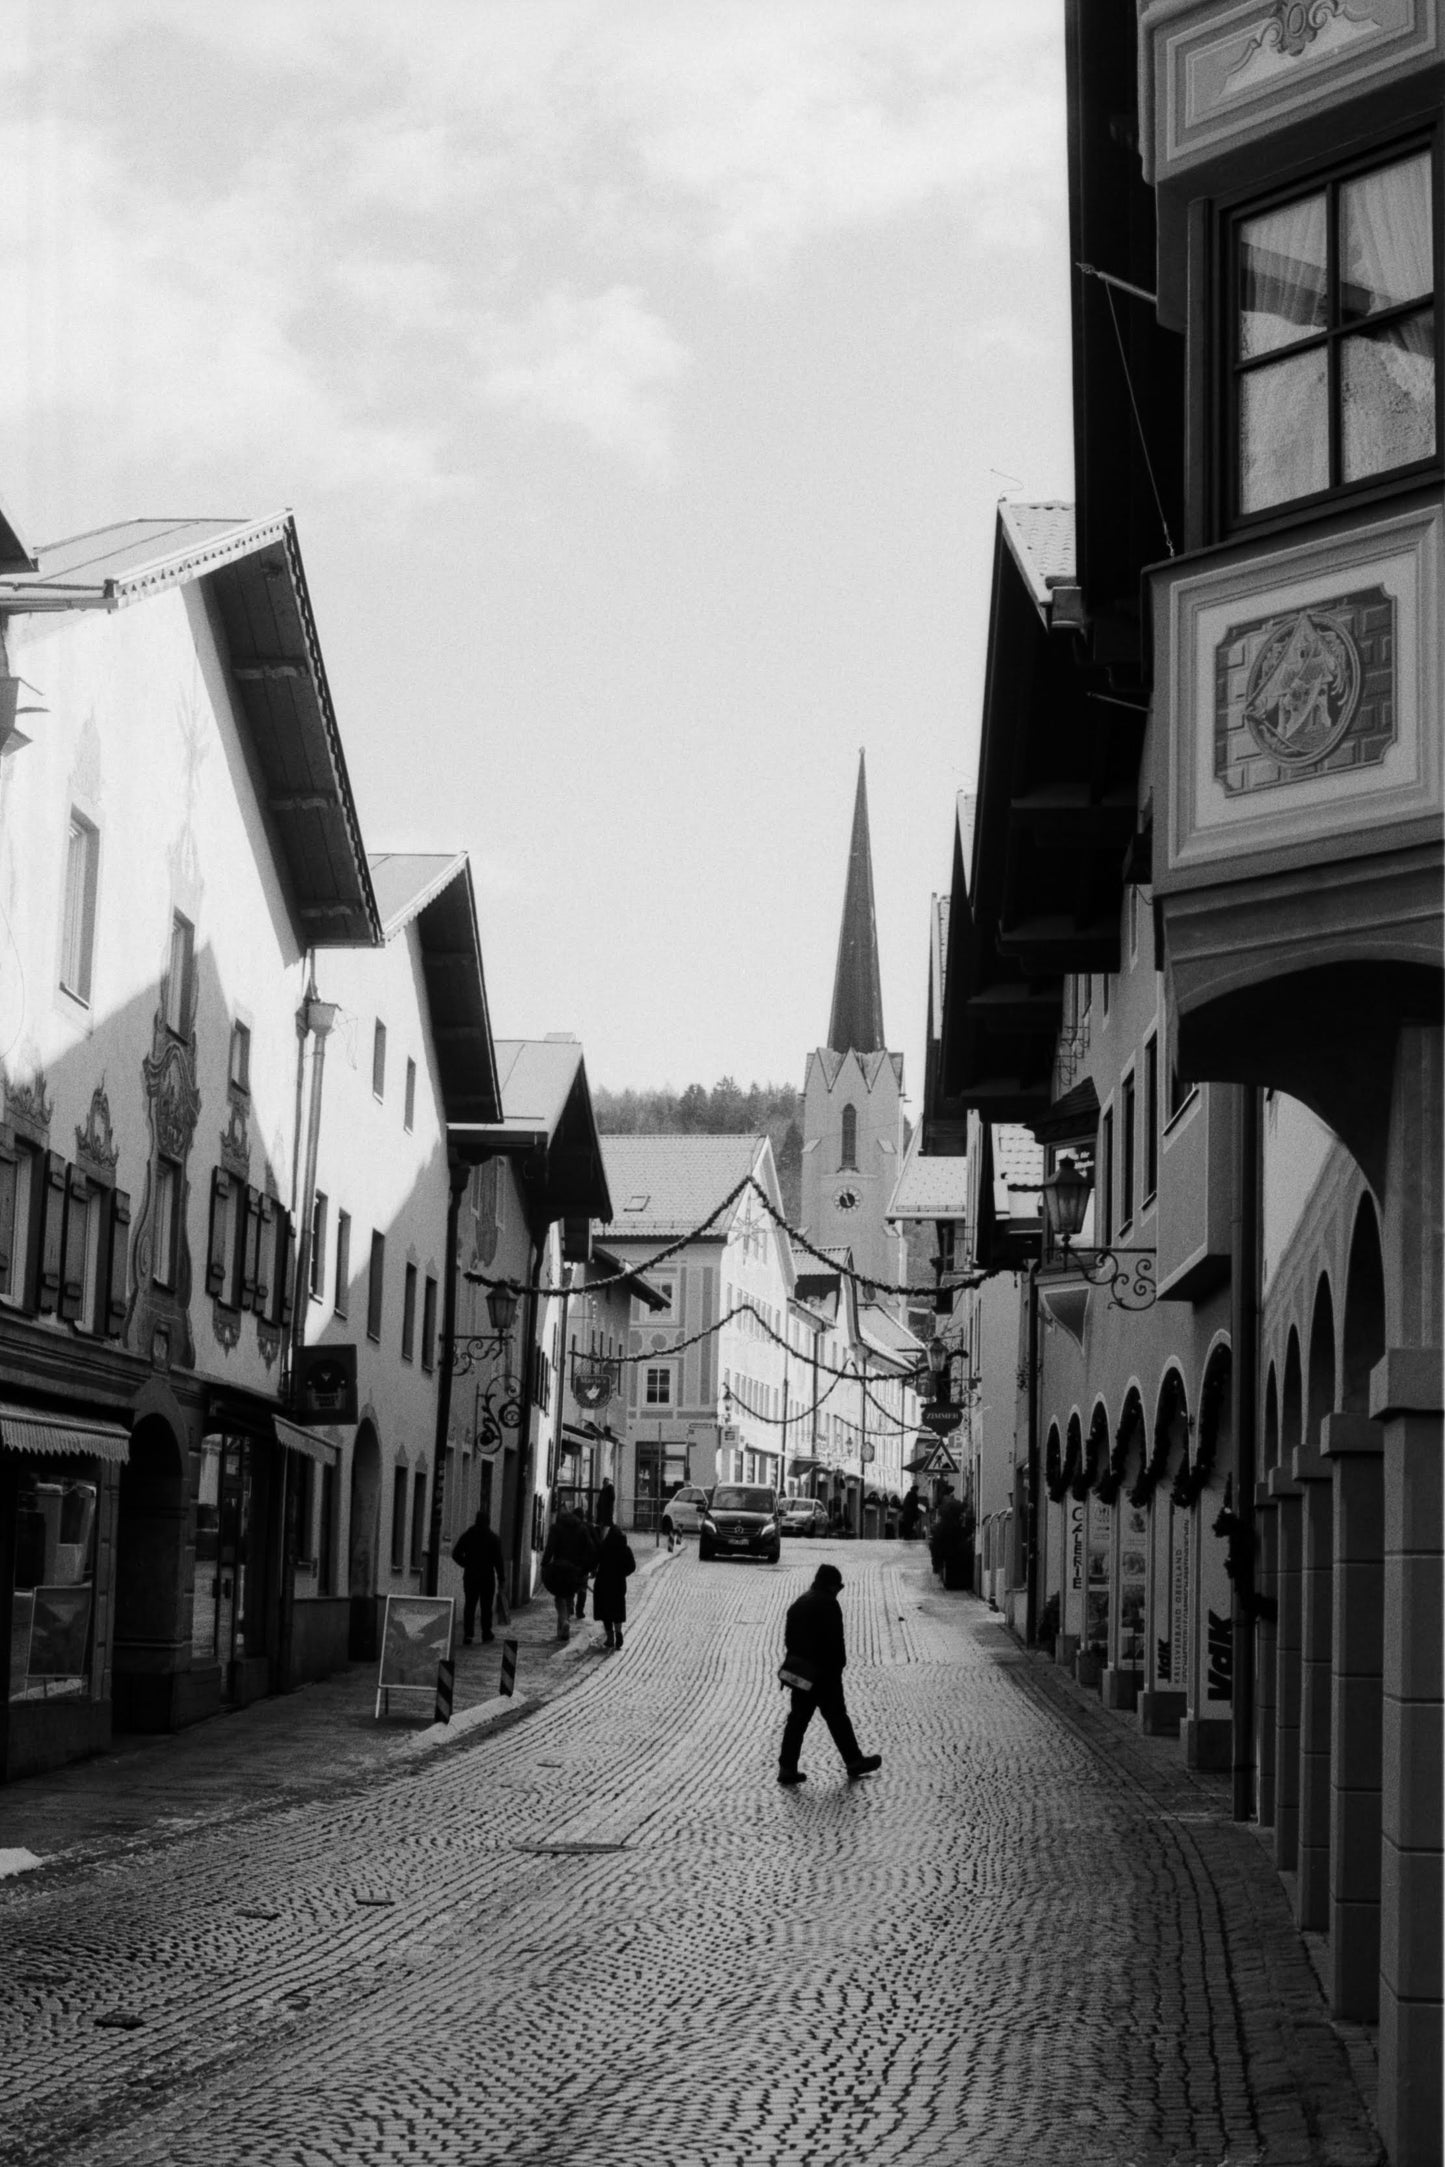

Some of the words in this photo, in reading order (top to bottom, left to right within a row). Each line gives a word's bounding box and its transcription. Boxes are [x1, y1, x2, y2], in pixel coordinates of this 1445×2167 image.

[926, 1412, 959, 1420] ZIMMER
[1175, 1548, 1183, 1604] OBERLAND
[1158, 1638, 1170, 1679] VdK
[1173, 1608, 1182, 1684] KREISVERBAND
[1207, 1609, 1232, 1701] VdK
